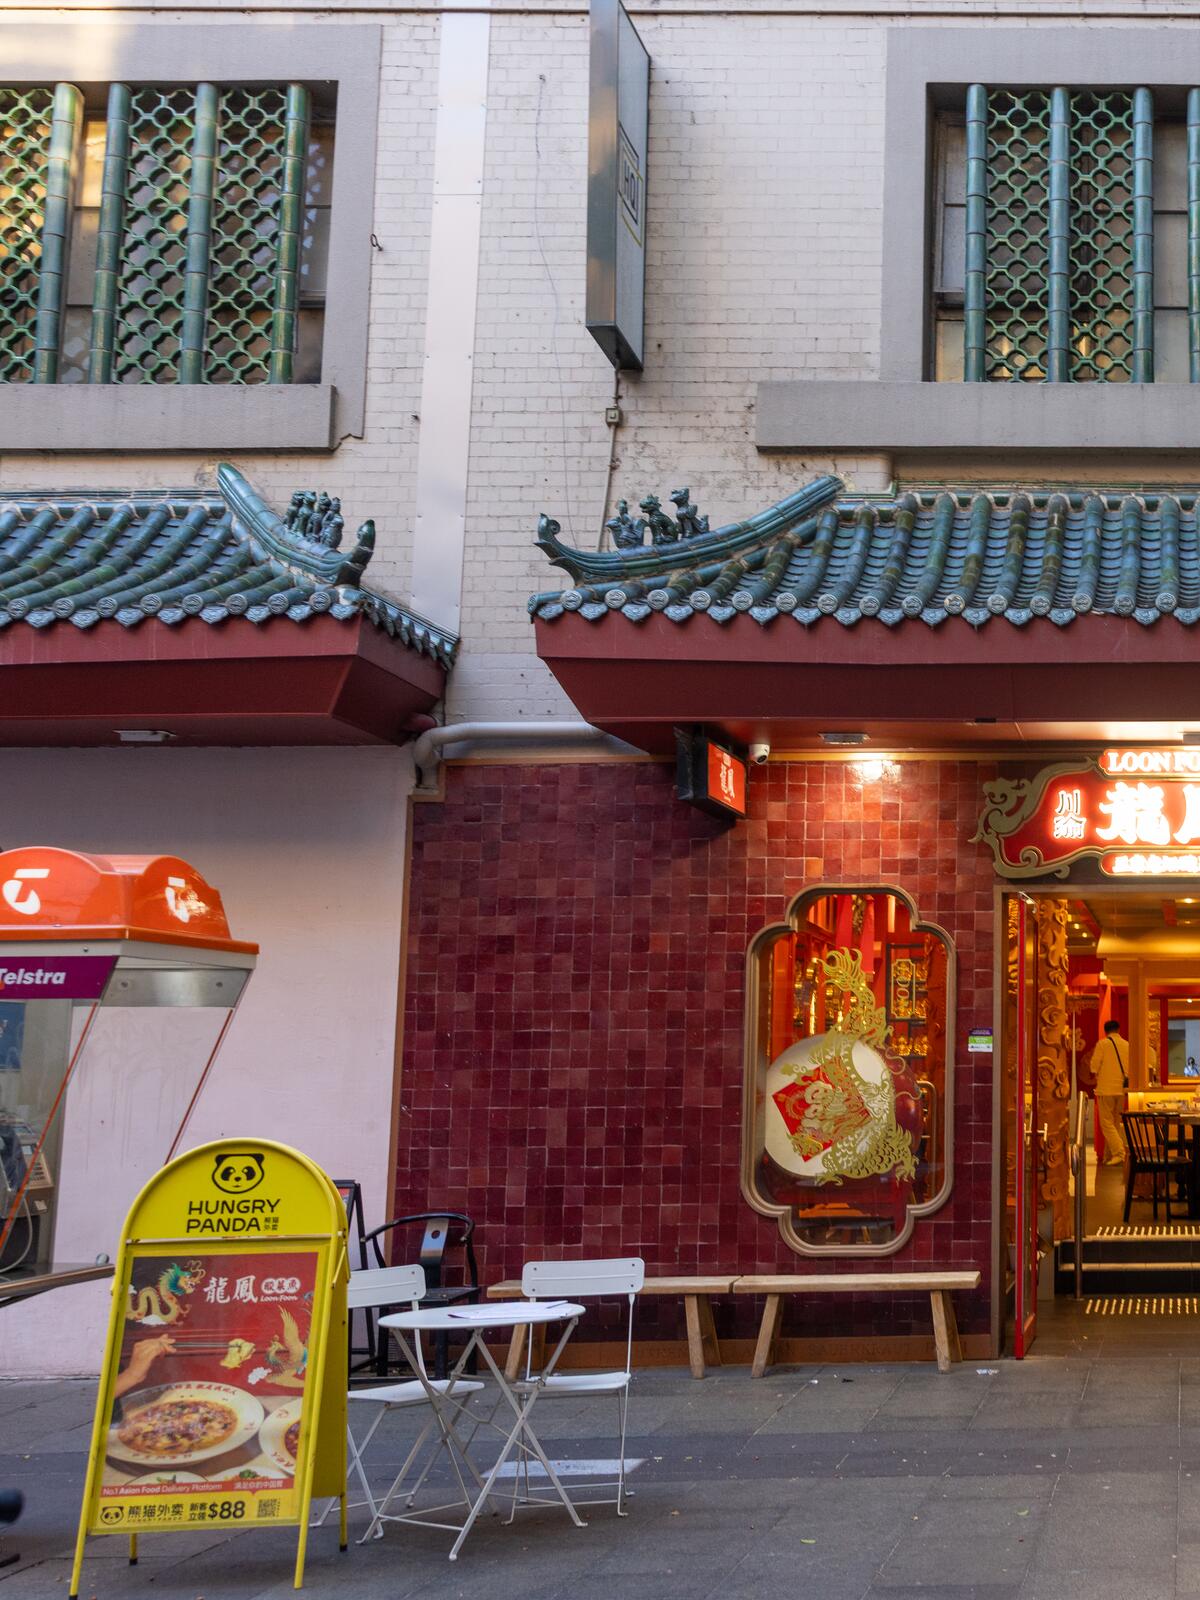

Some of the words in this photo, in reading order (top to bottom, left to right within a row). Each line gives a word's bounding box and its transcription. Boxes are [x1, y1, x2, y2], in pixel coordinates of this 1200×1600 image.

[1107, 751, 1172, 772] LOON
[188, 1199, 281, 1215] HUNGRY
[186, 1217, 261, 1233] PANDA
[203, 1275, 258, 1303] 龍鳳
[119, 1486, 141, 1494] Asian
[208, 1500, 245, 1521] $88
